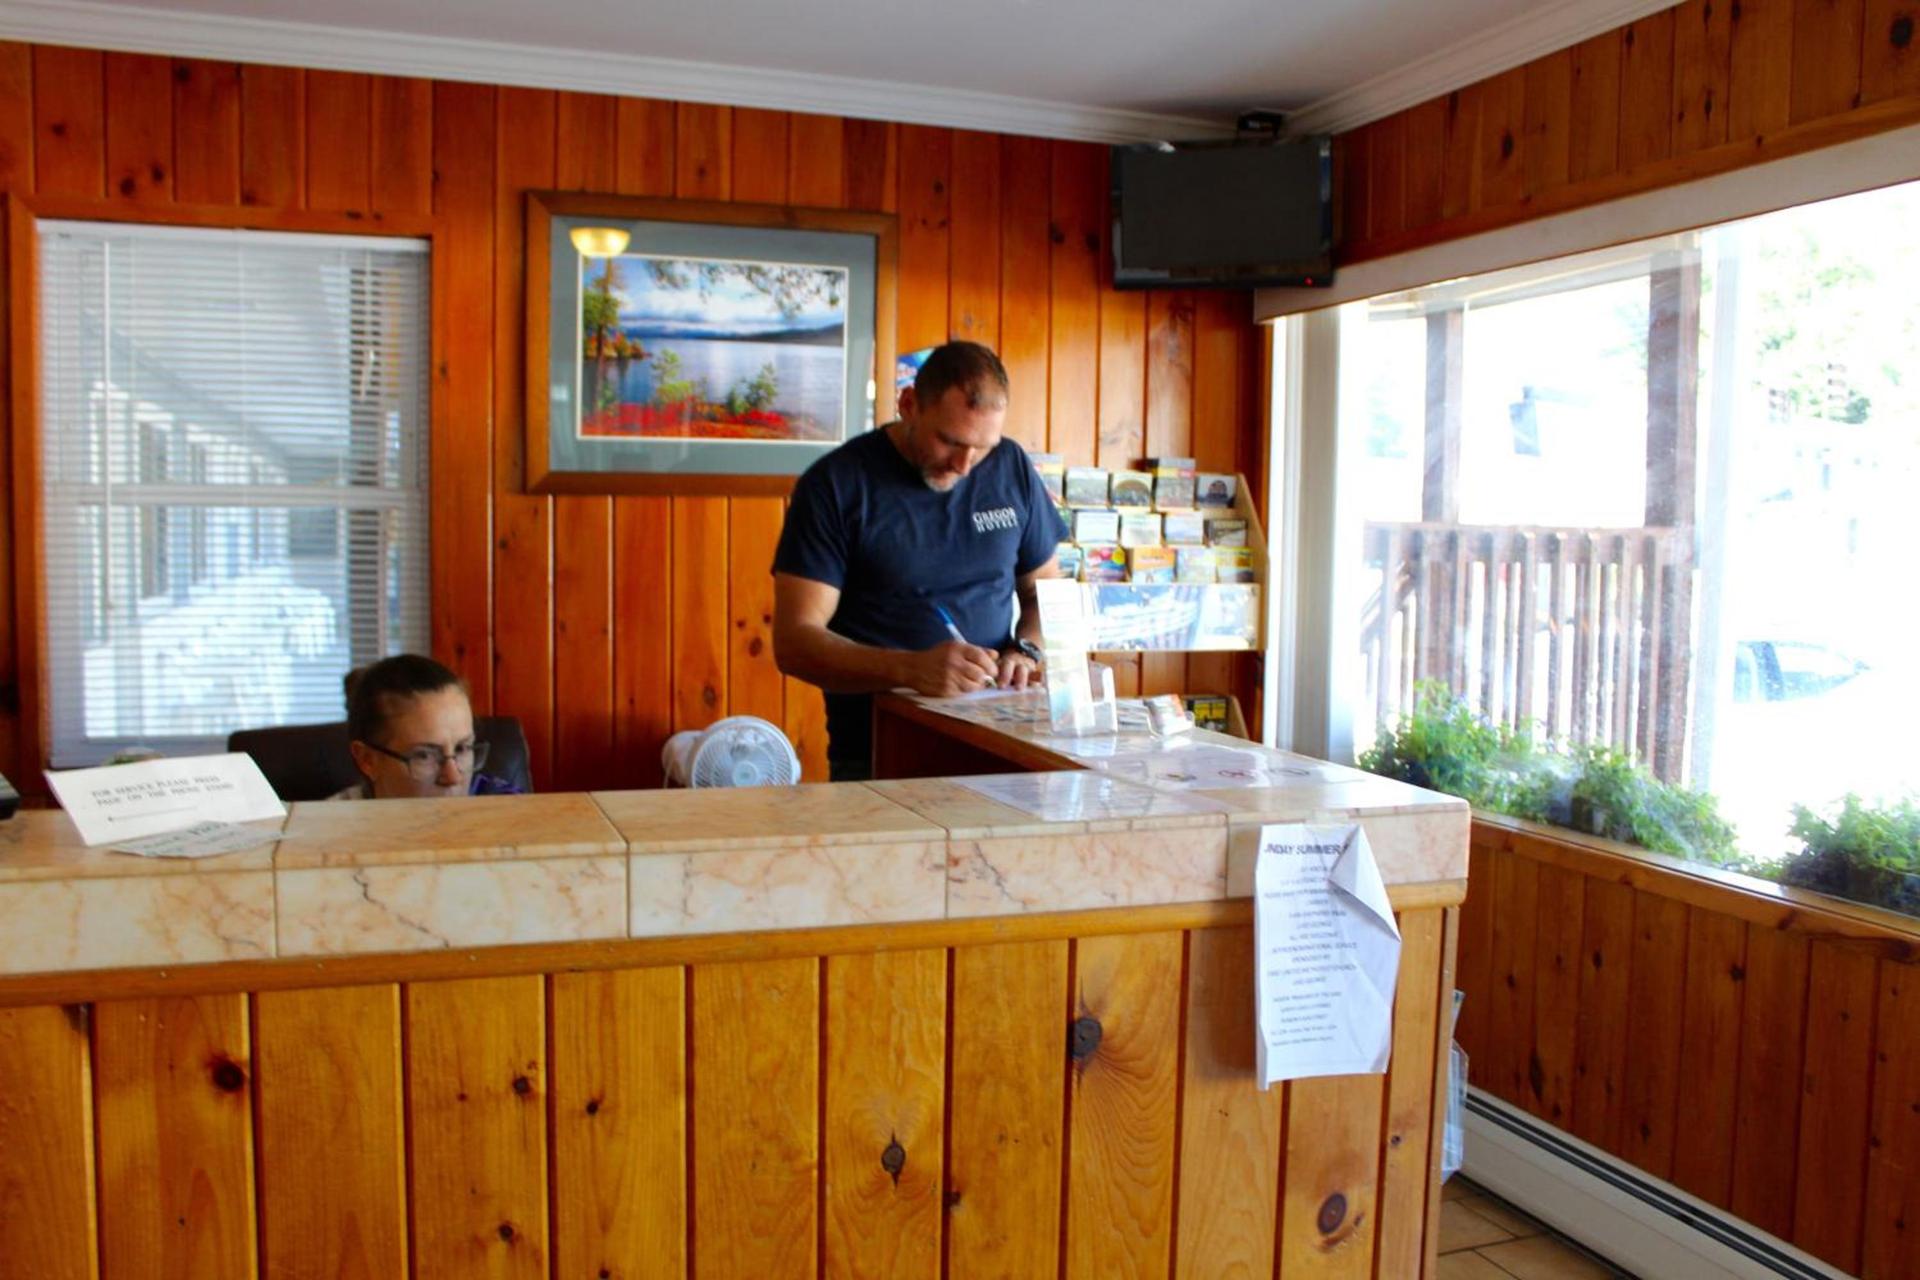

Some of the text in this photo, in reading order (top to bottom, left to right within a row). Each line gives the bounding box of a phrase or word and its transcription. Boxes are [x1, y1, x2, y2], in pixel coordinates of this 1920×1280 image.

[115, 783, 153, 794] SERVICE
[155, 779, 189, 788] PLEASE
[1296, 843, 1341, 855] SUMMER
